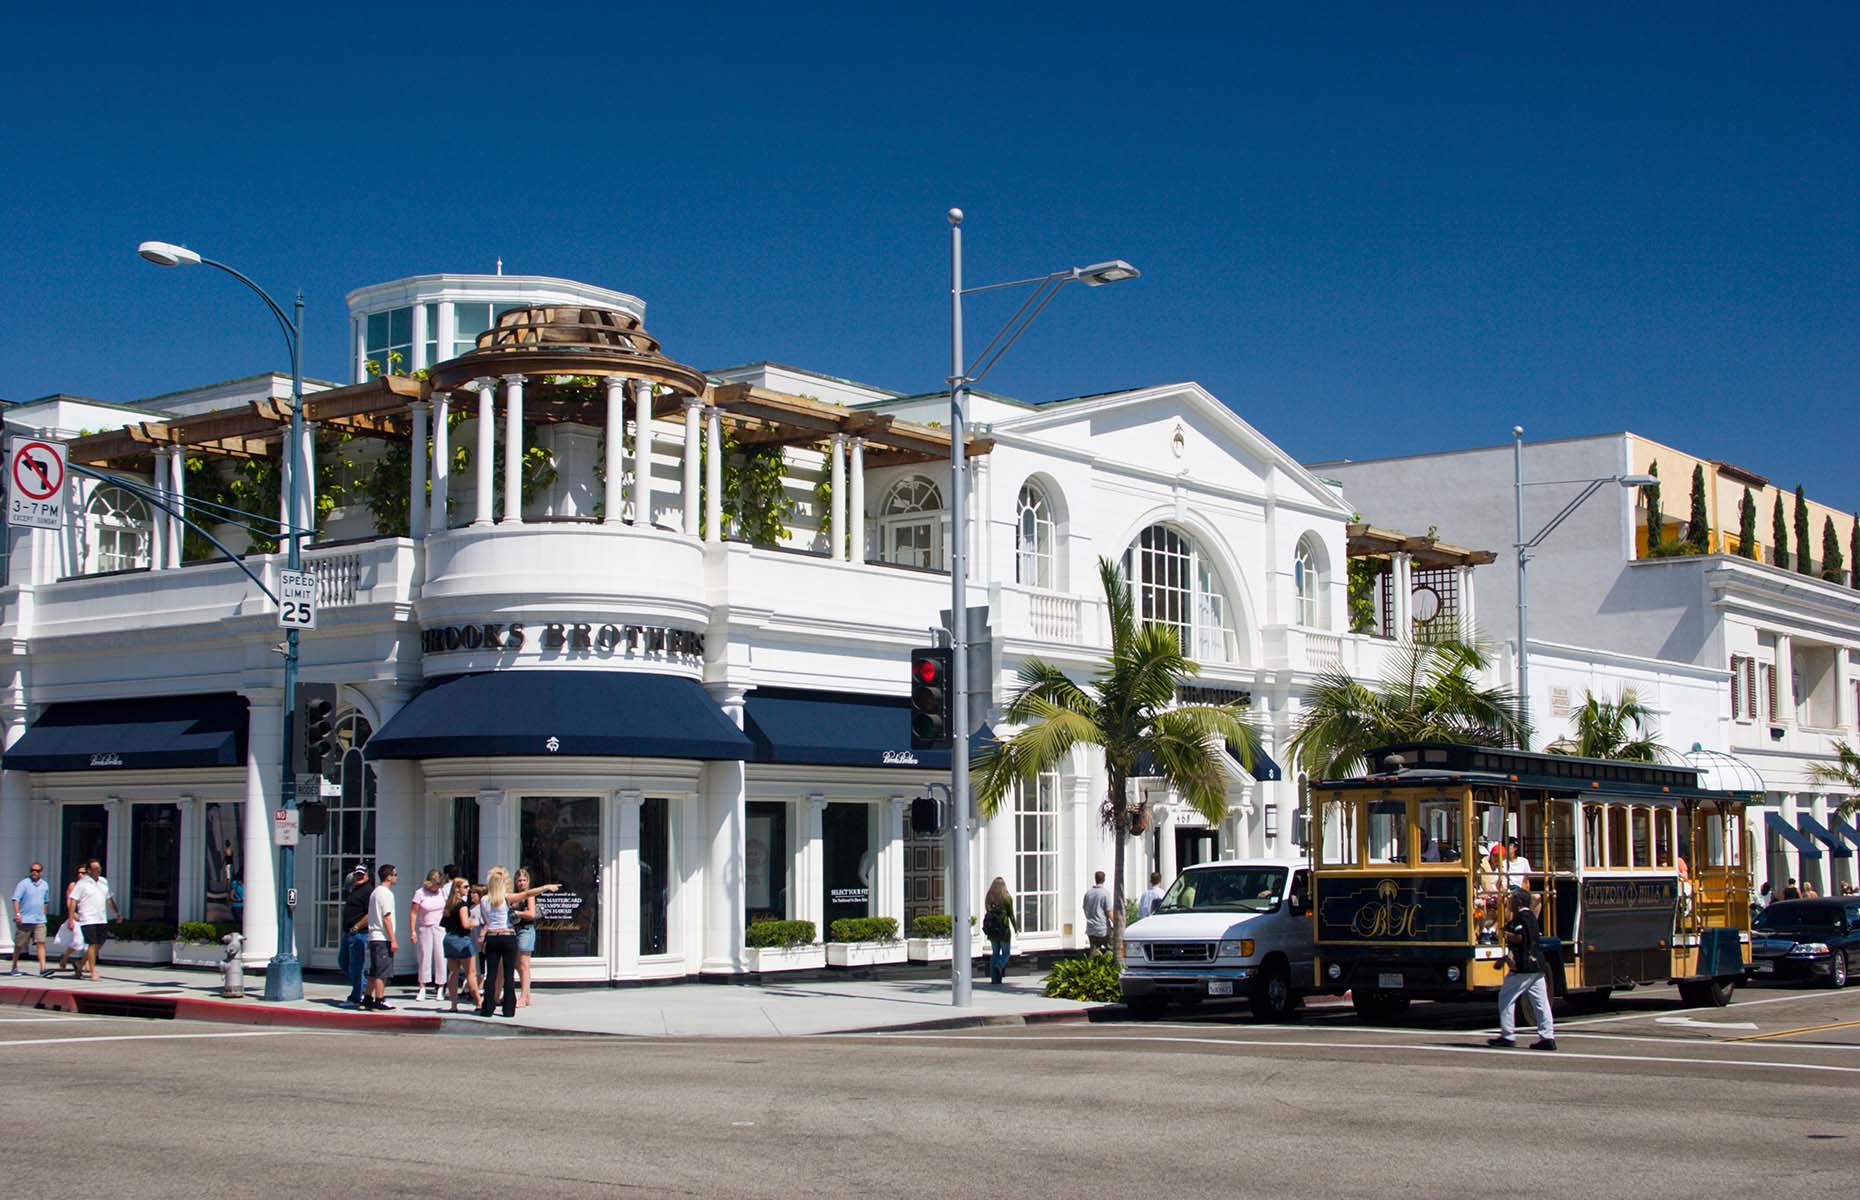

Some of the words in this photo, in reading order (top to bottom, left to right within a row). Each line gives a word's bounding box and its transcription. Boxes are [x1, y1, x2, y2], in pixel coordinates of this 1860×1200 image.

[13, 500, 38, 514] 3-7
[41, 504, 58, 517] PM
[282, 575, 314, 587] SPEED
[285, 589, 311, 599] LIMIT
[282, 601, 311, 624] 25
[422, 623, 525, 653] BROOKS
[543, 623, 704, 656] BROTHERS
[276, 811, 286, 820] NO
